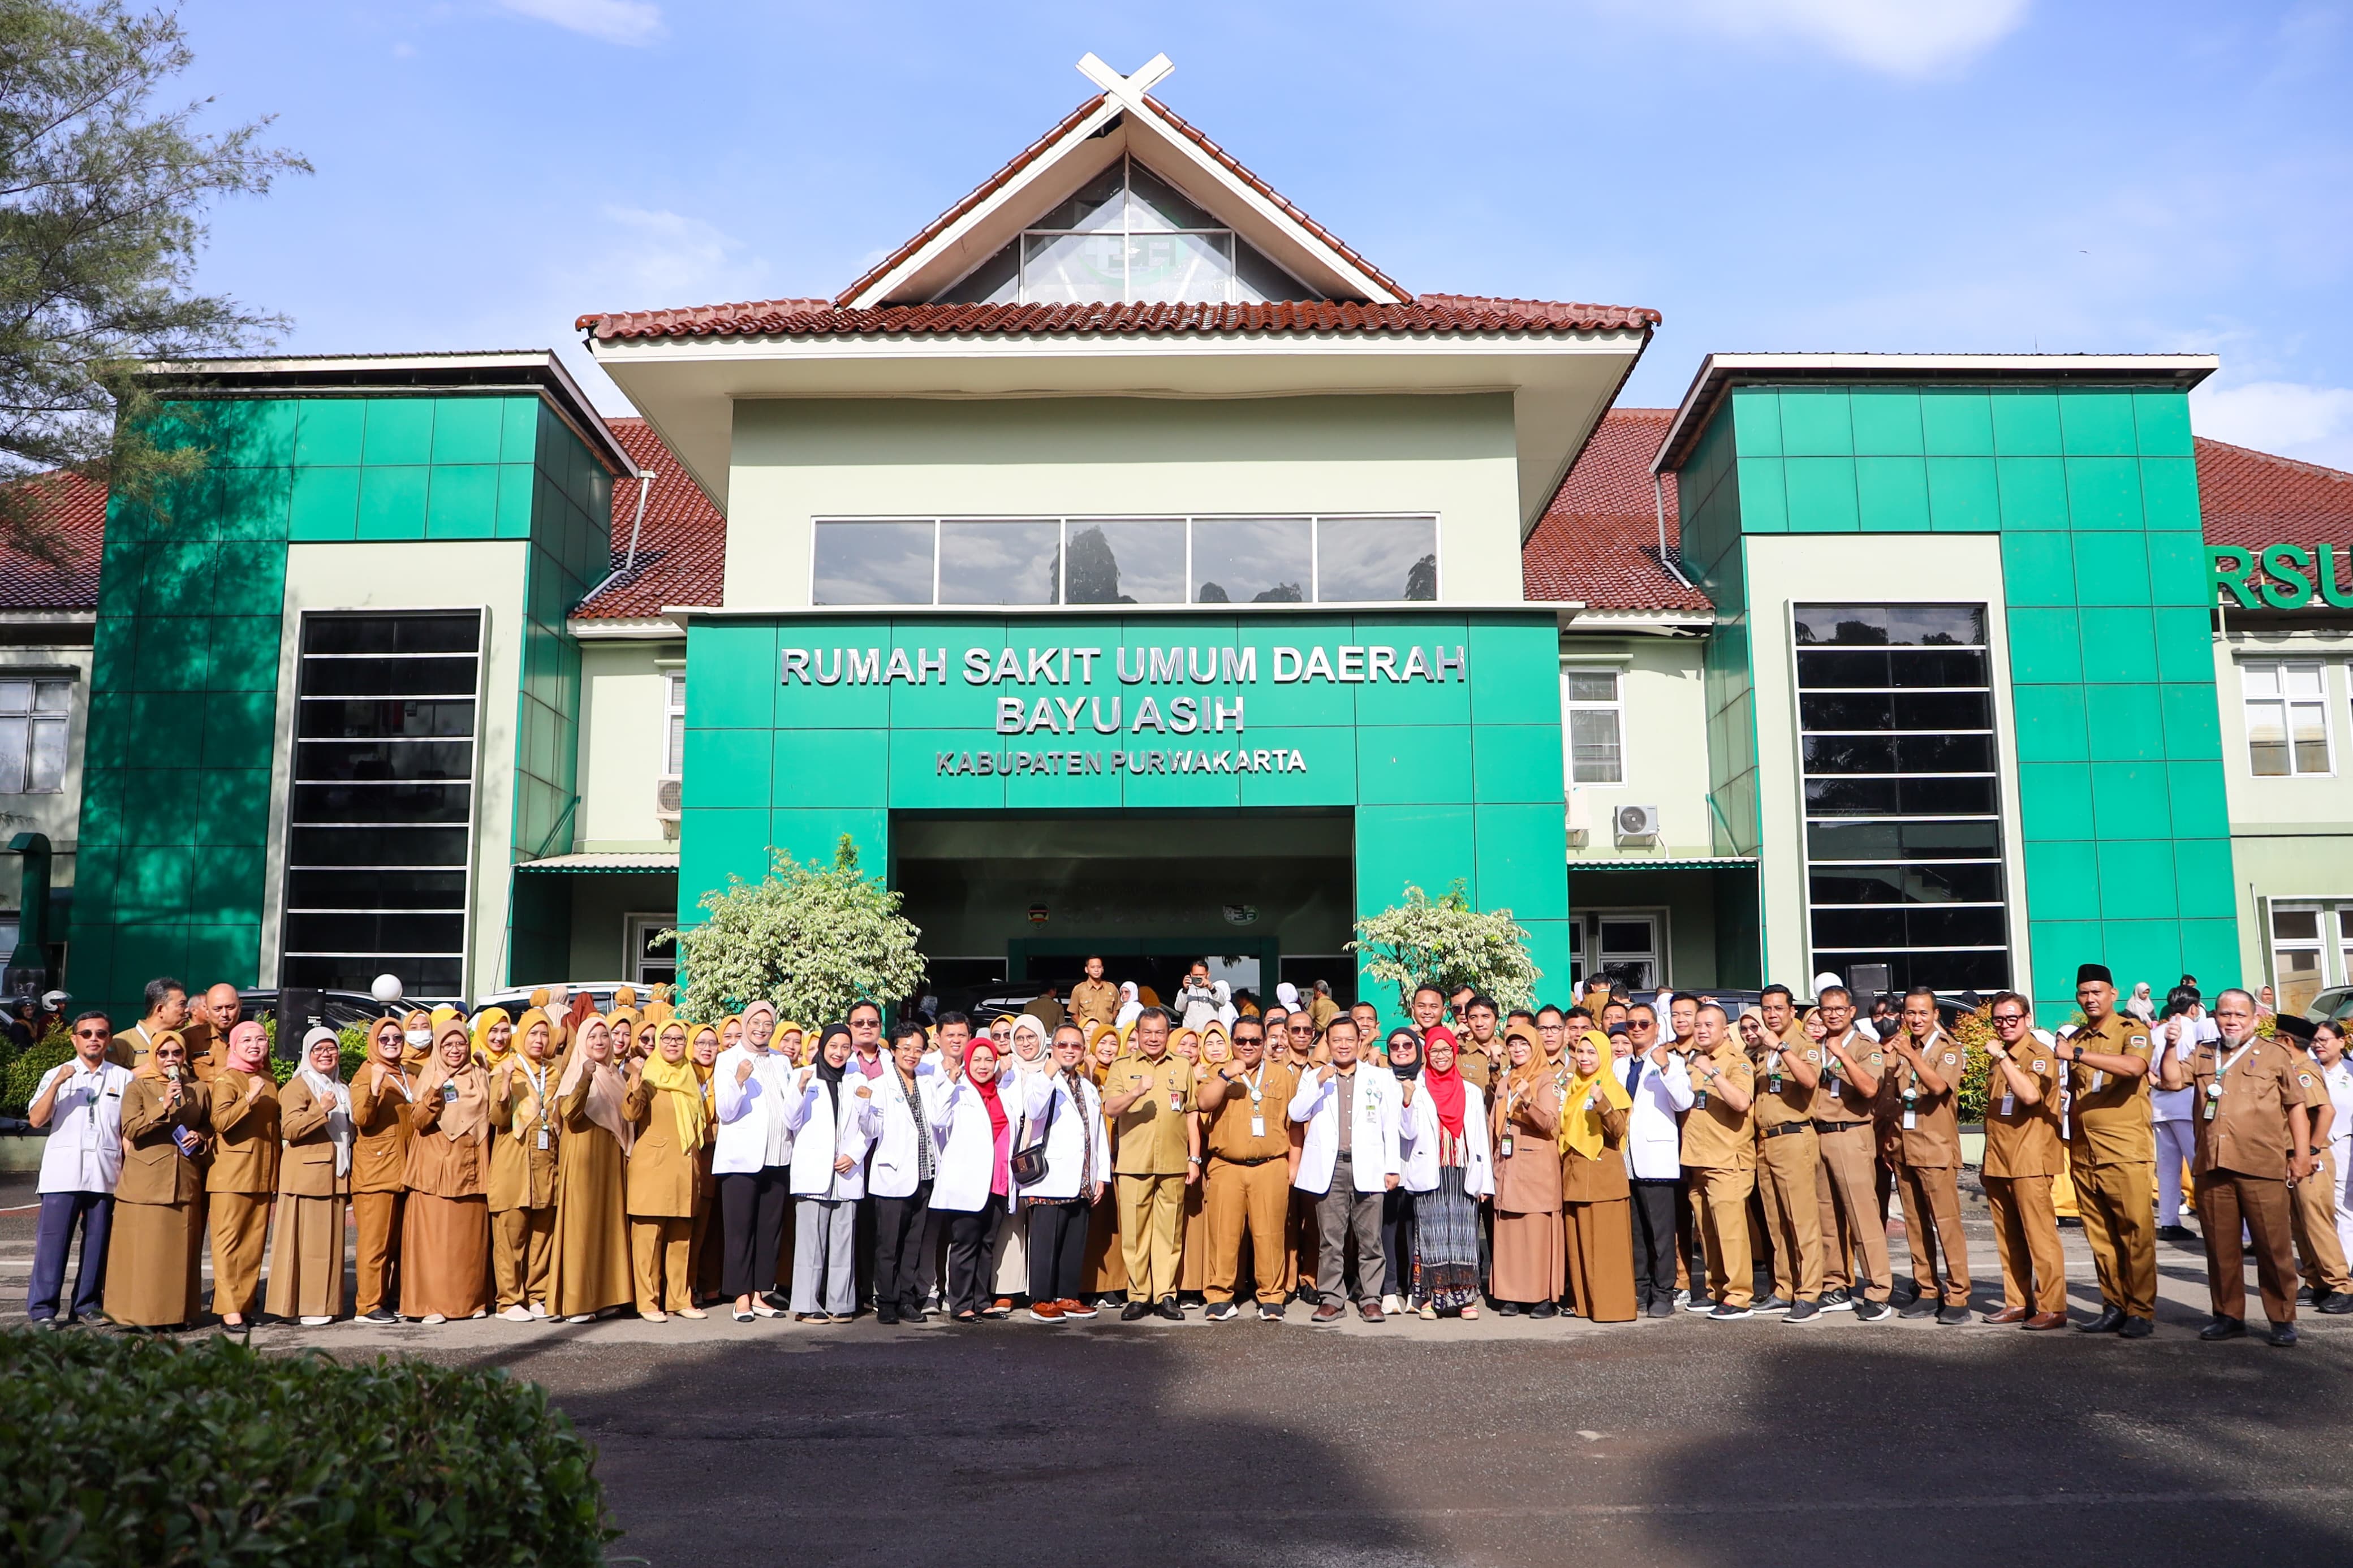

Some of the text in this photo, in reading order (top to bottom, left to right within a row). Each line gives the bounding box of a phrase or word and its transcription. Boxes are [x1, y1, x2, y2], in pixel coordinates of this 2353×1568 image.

[2204, 543, 2353, 610] RSU
[781, 645, 1465, 685] RUMAH SAKIT UMUM DAERAH
[996, 696, 1244, 734] BAYU ASIH
[936, 749, 1307, 775] KABUPATEN PURWAKARTA
